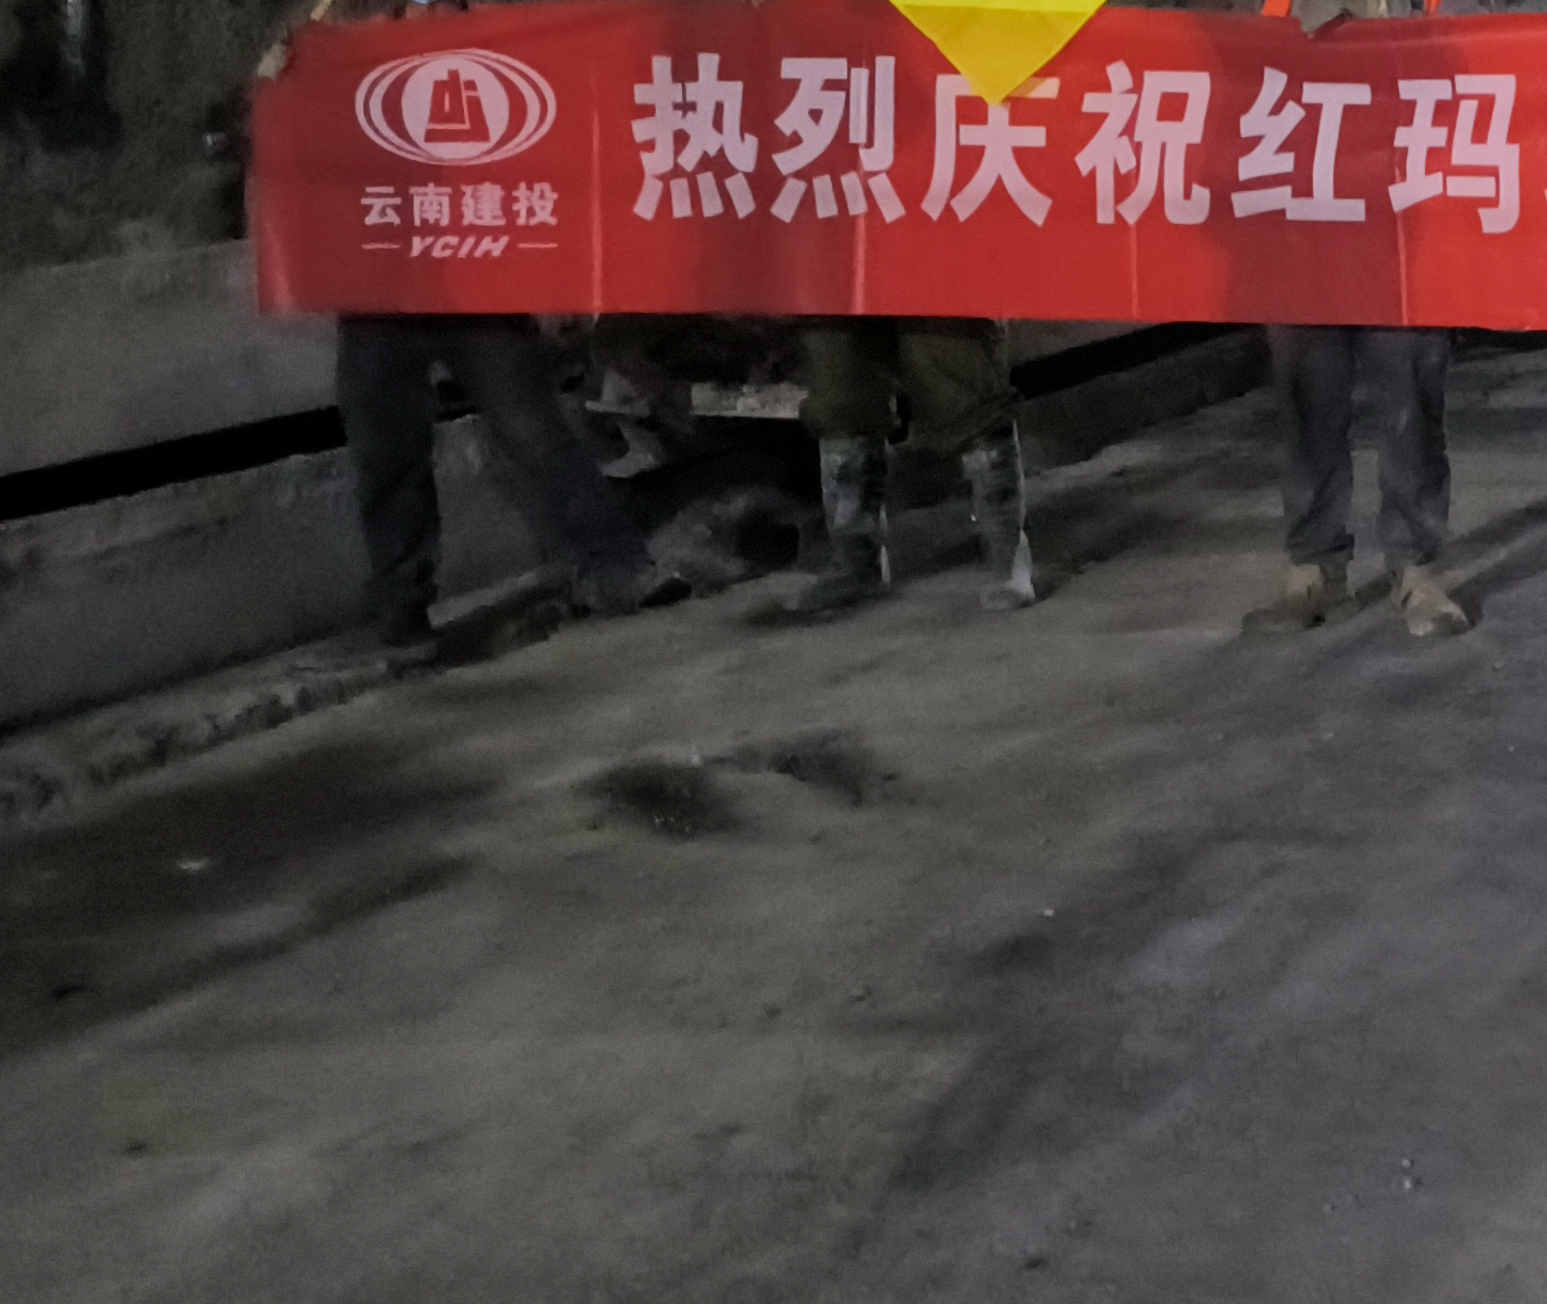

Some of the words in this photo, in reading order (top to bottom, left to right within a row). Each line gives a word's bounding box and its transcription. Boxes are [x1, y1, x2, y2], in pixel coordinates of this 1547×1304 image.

[361, 181, 558, 227] 云南建投
[409, 235, 509, 258] YCIH
